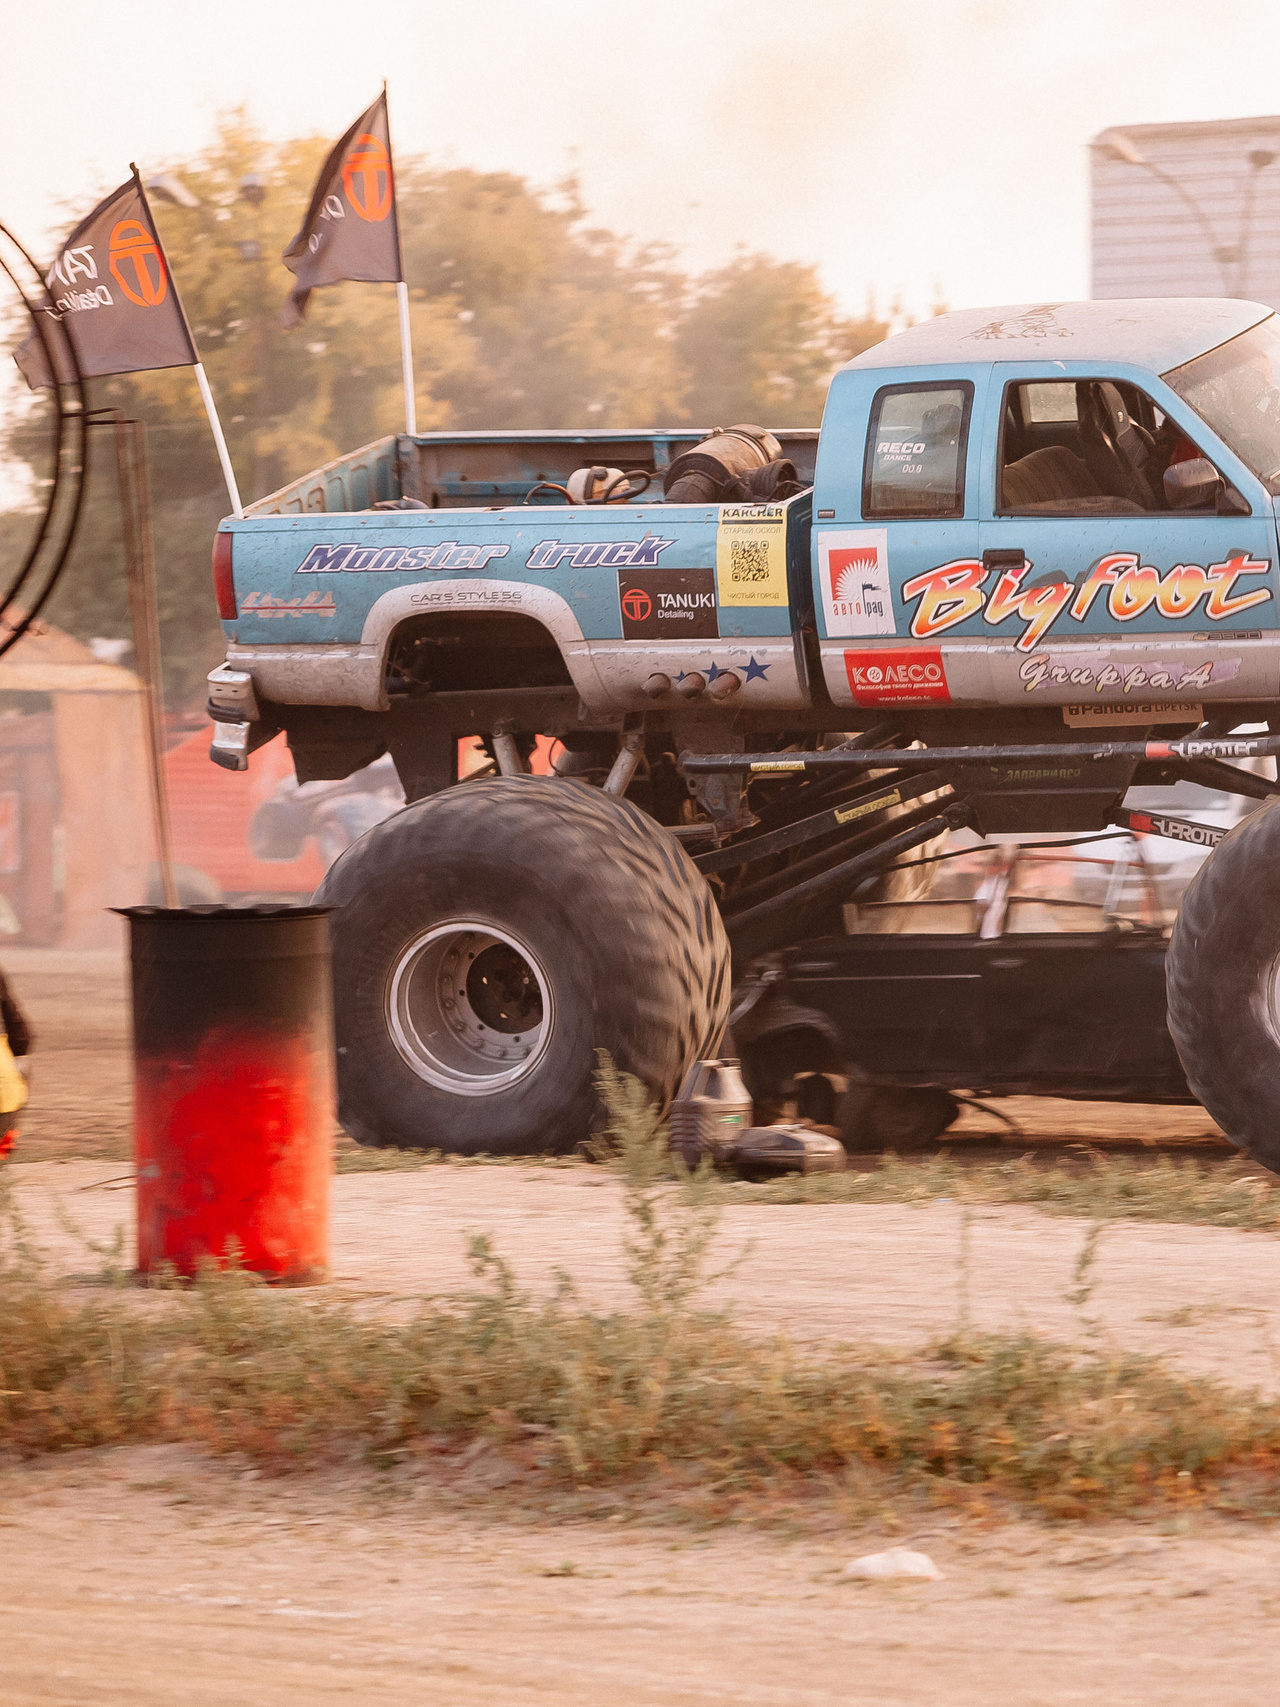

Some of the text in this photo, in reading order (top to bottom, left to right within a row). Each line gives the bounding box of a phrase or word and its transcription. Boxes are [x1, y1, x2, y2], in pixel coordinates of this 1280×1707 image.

[877, 442, 926, 454] RECO
[723, 526, 755, 535] СТАРЫЙ
[296, 535, 681, 575] Monster truck
[410, 592, 453, 603] CAR'S
[457, 592, 498, 601] STYLE
[657, 593, 715, 608] TANUKI
[903, 552, 1273, 653] Bigfoot
[658, 609, 695, 620] Detailing
[852, 663, 941, 684] КОЛЕСО
[1019, 654, 1173, 694] Gruppa
[1153, 819, 1225, 846] UPROTE
